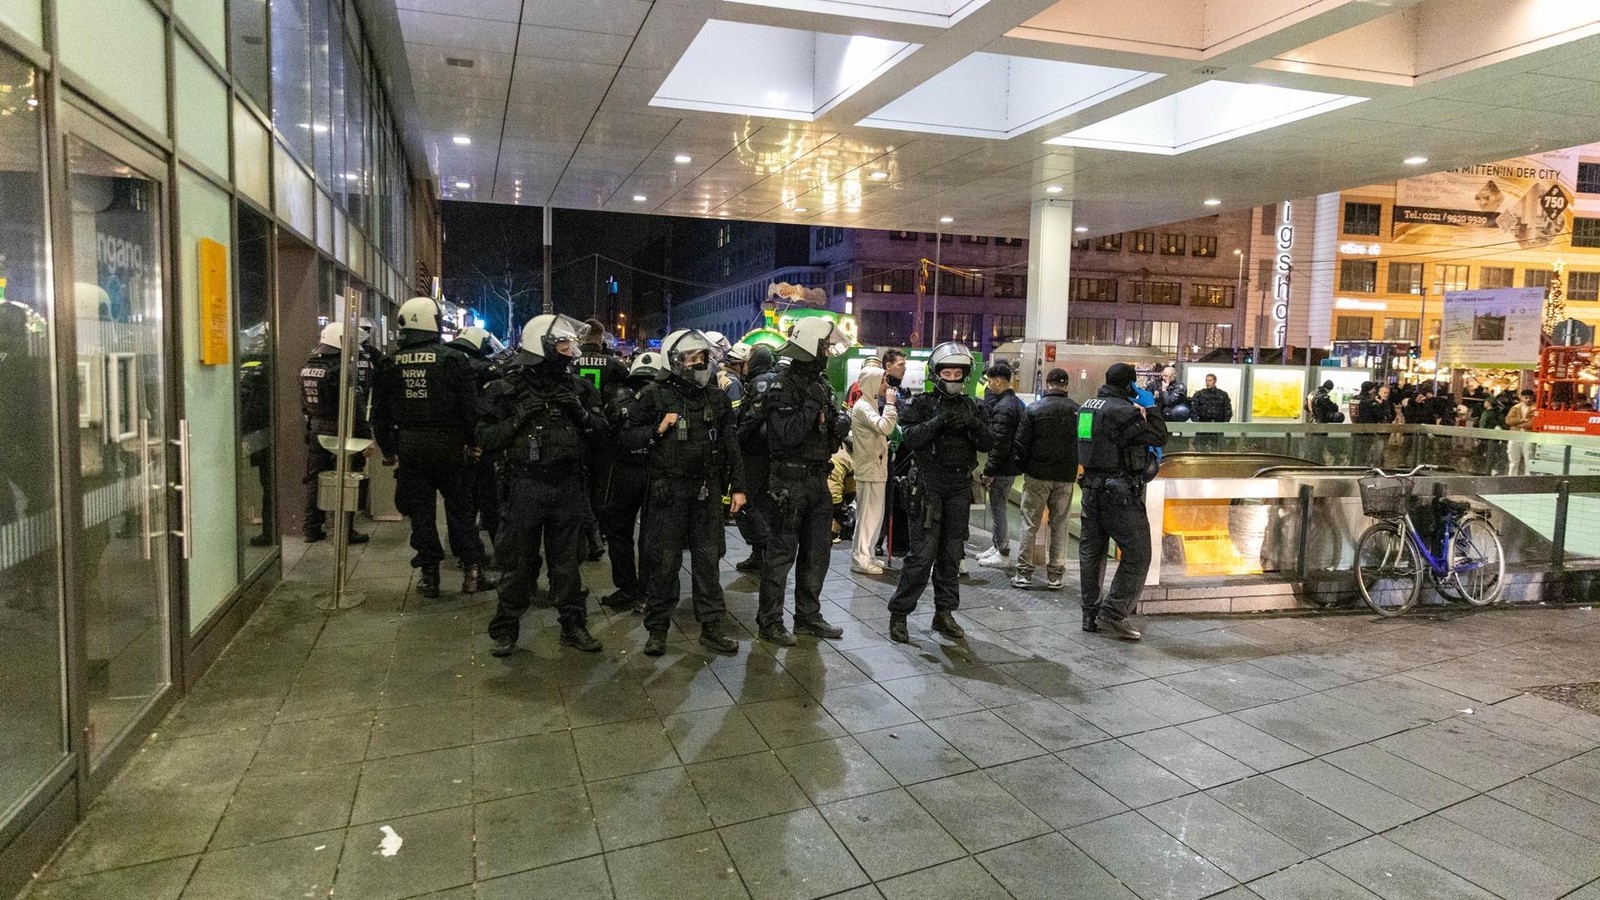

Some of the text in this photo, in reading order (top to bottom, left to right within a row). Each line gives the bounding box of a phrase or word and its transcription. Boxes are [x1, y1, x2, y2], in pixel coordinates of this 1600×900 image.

[1462, 165, 1500, 176] MITTEN
[1503, 166, 1513, 177] IN
[1516, 168, 1536, 179] DER
[1539, 169, 1562, 180] CITY
[1544, 196, 1565, 209] 750
[1422, 212, 1441, 221] 0221
[411, 313, 418, 324] 4
[793, 329, 800, 340] 4
[395, 352, 437, 365] POLIZEI
[301, 368, 326, 378] POLIZEI
[402, 369, 427, 378] NRW
[406, 379, 427, 388] 1242
[405, 389, 428, 398] BeSi
